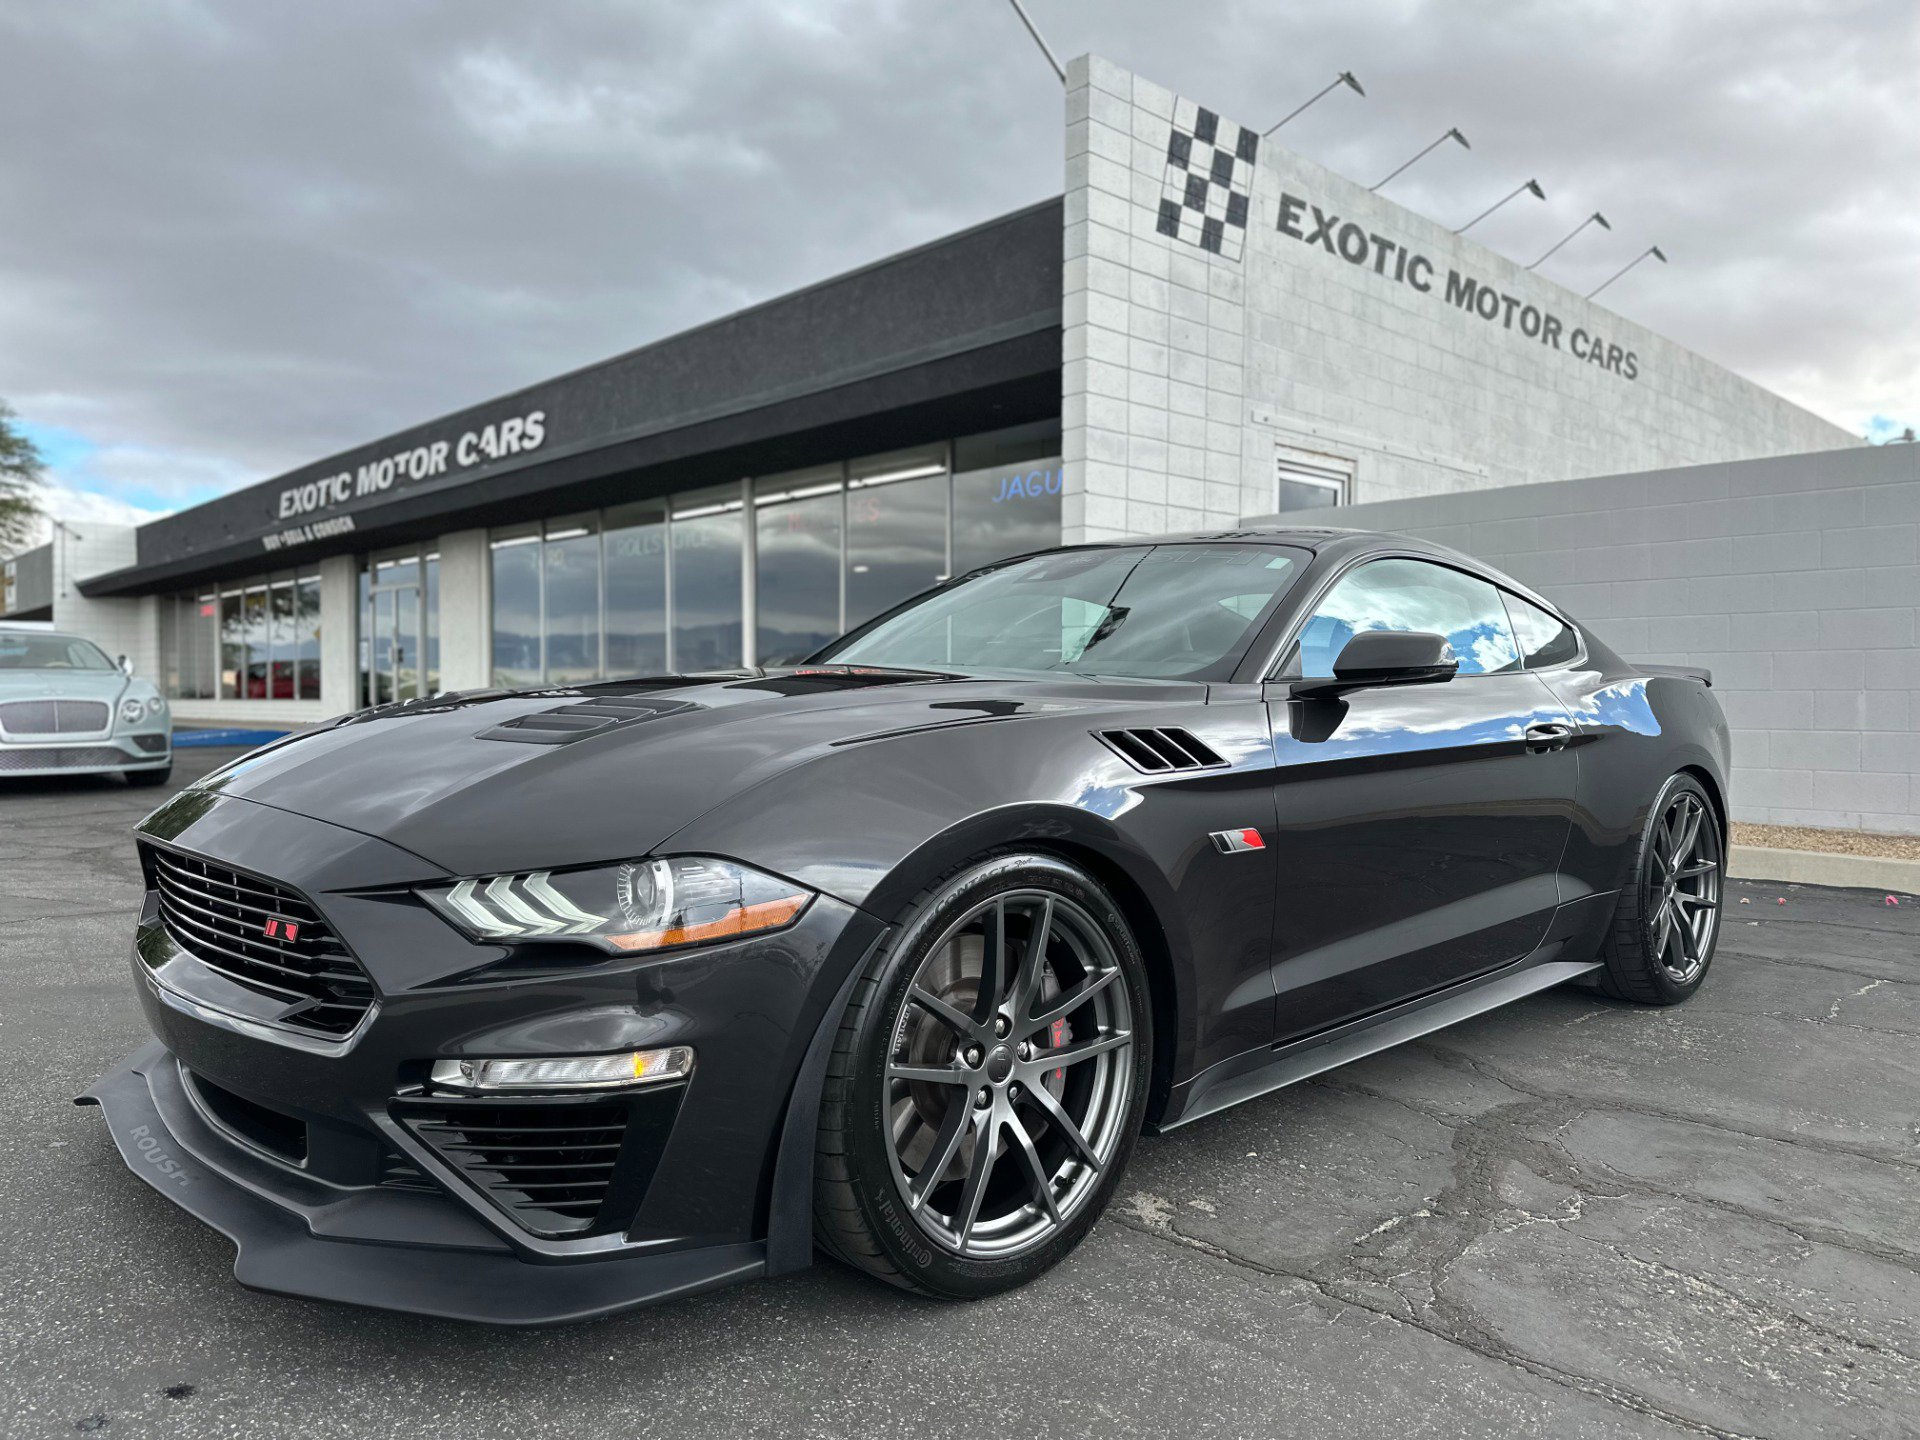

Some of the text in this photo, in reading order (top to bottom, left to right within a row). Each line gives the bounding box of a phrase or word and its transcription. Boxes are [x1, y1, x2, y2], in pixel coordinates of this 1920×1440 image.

[1276, 192, 1639, 381] EXOTIC MOTOR CARS
[278, 410, 545, 519] EXOTIC MOTOR CARS
[129, 1124, 191, 1187] ROUSH
[878, 1199, 933, 1269] Continental
